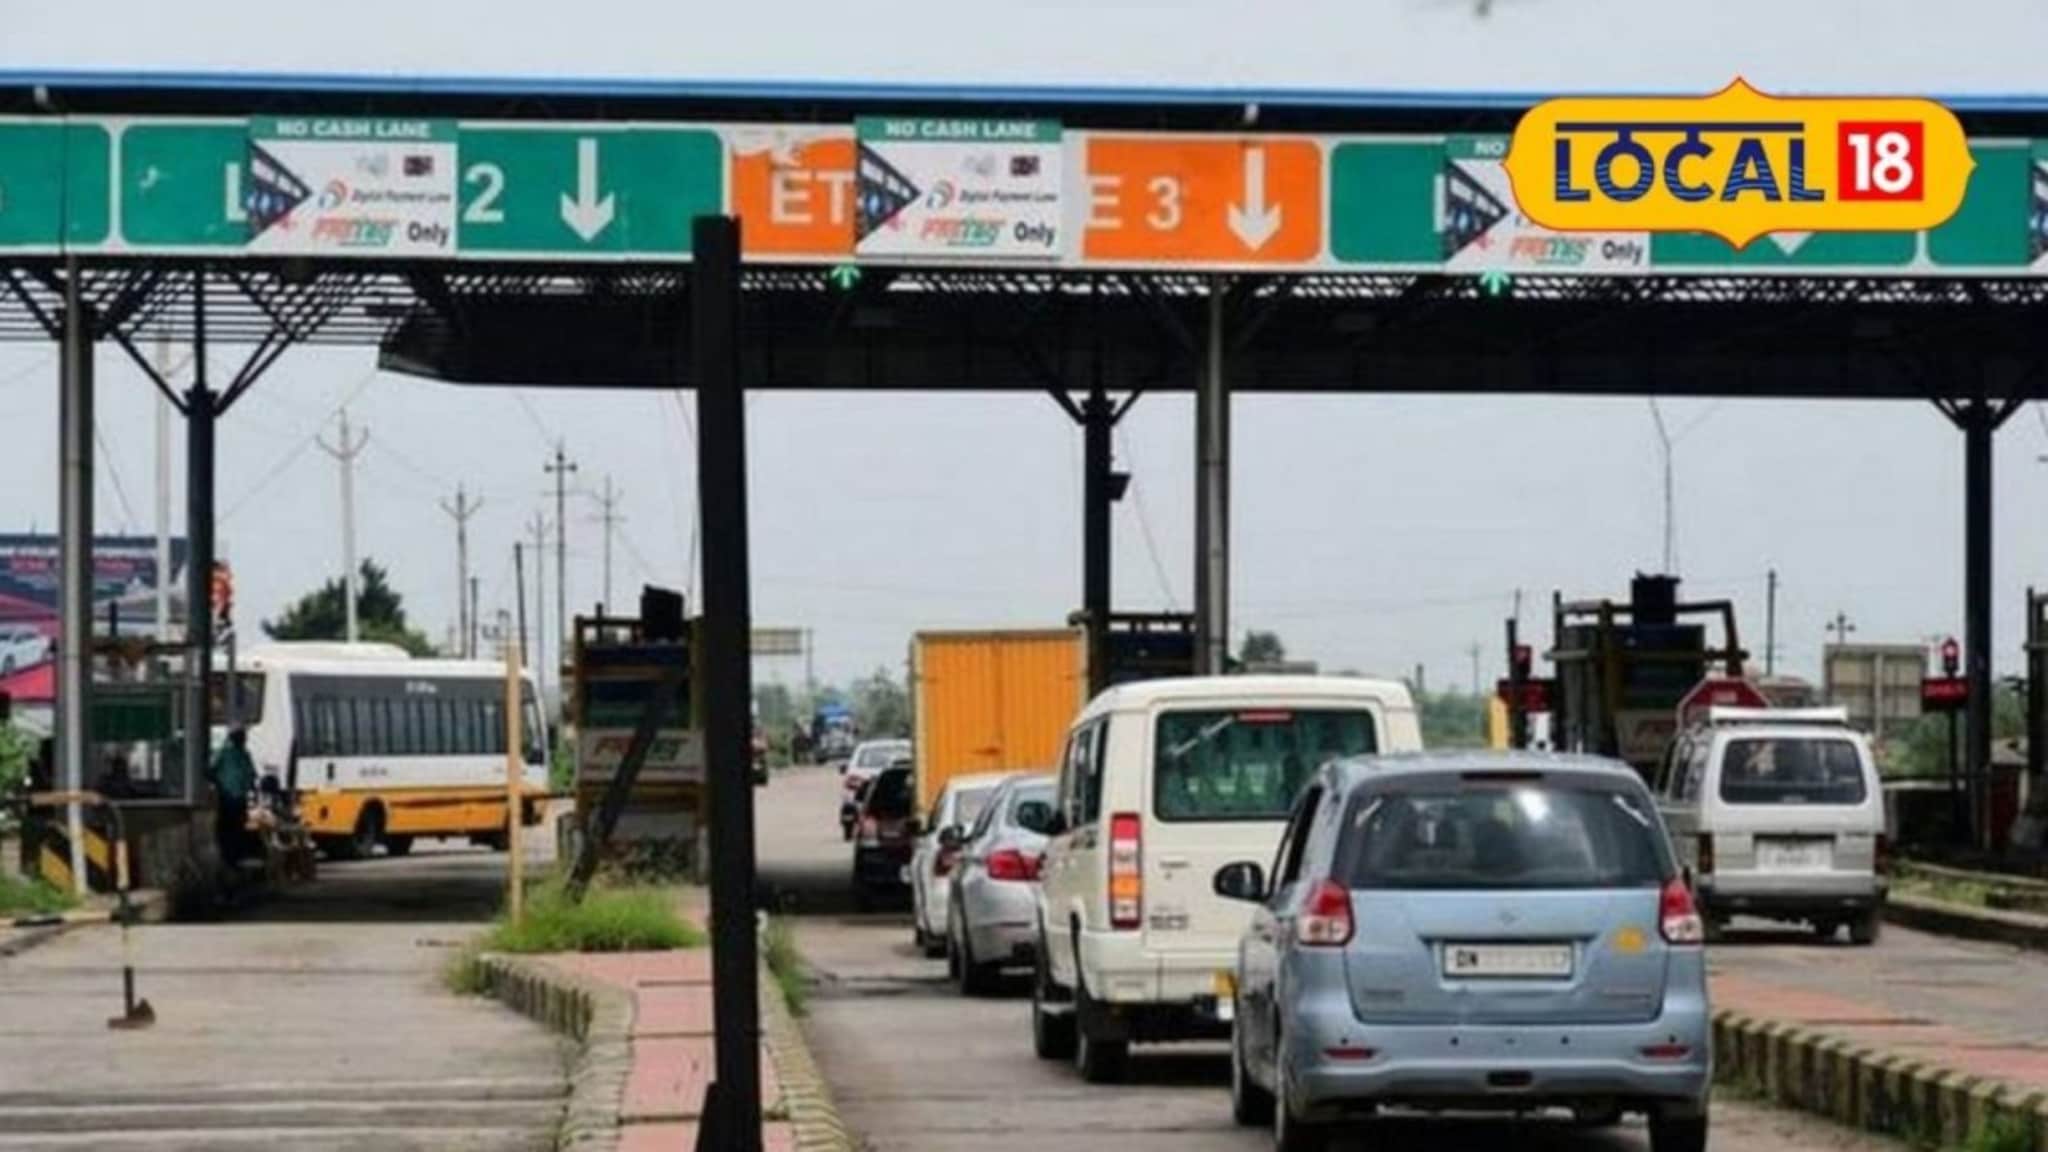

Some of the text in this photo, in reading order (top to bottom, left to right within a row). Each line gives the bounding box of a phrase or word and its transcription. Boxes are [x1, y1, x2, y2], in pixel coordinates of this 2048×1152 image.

[276, 120, 431, 138] NO CASH LANE
[885, 121, 1037, 138] NO CASH LANE
[1474, 140, 1506, 155] NO
[463, 162, 504, 223] 2
[1146, 175, 1182, 231] 3
[407, 220, 450, 246] Only
[1013, 220, 1055, 247] Only
[1601, 239, 1643, 266] Only
